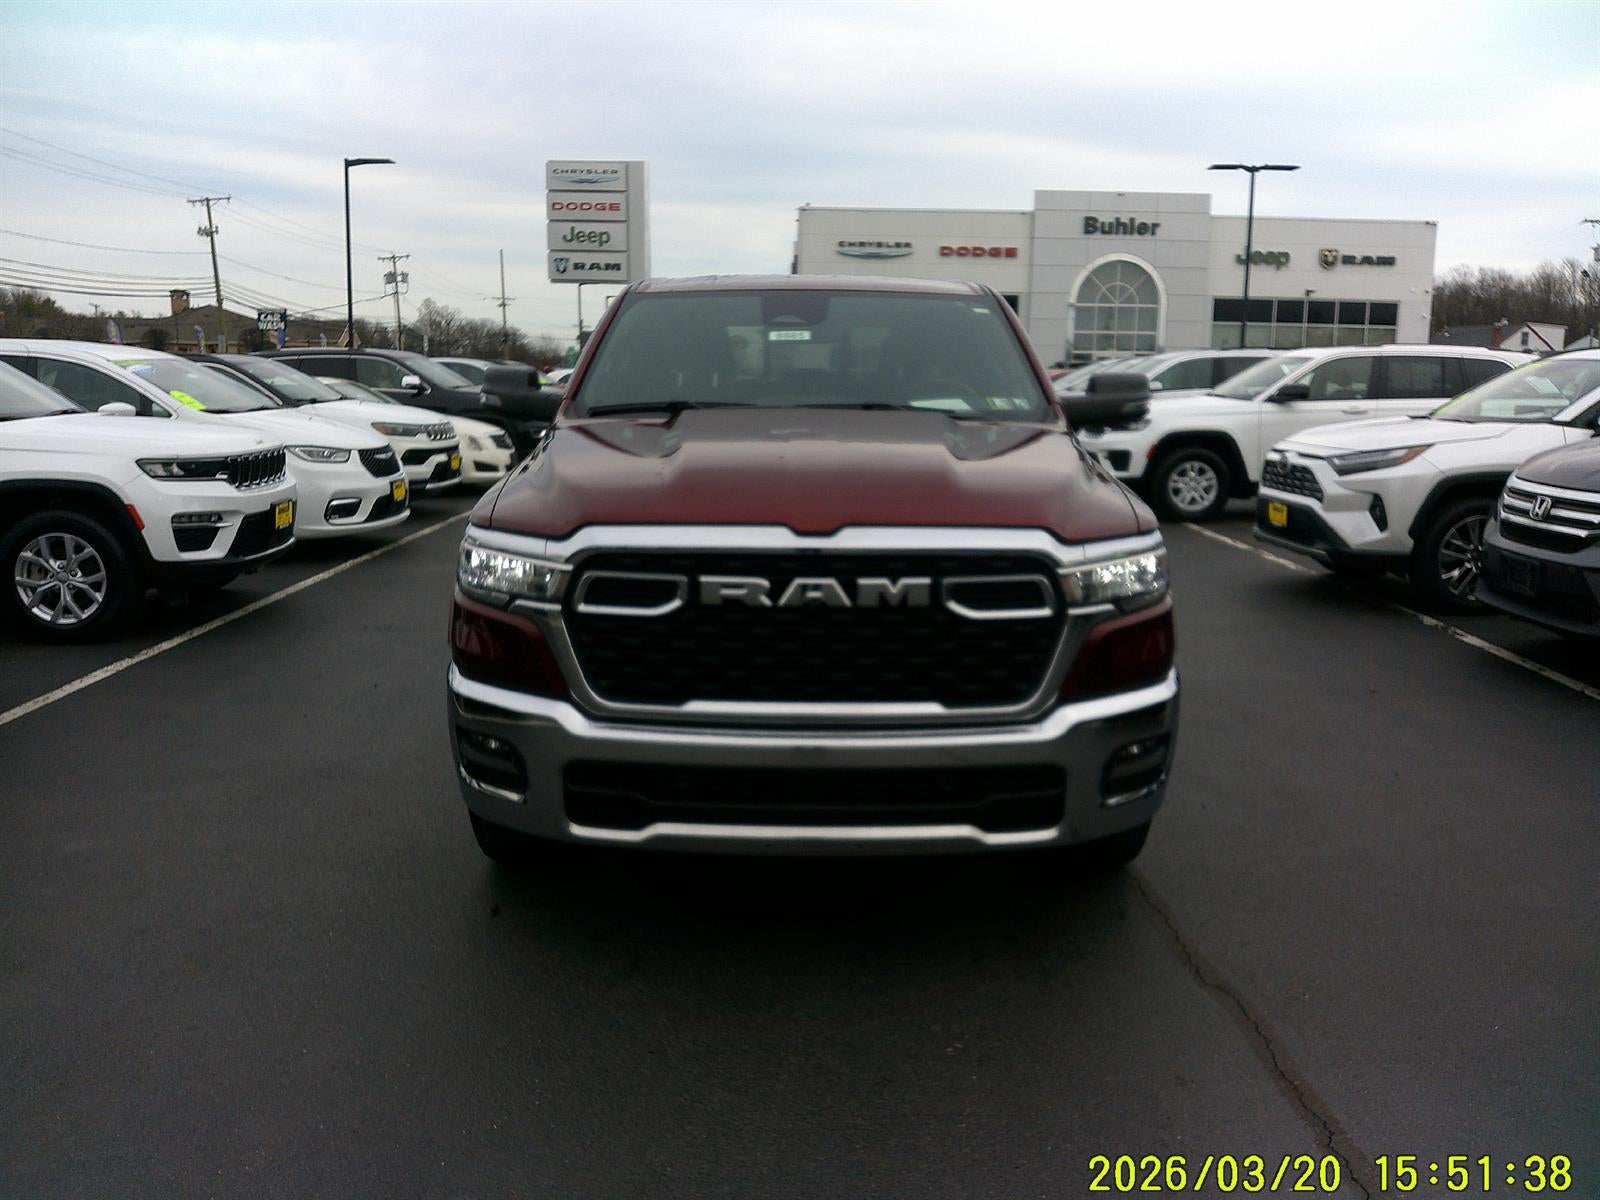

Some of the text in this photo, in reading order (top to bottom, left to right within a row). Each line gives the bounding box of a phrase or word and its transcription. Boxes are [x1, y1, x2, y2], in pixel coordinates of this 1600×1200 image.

[552, 167, 619, 175] CHRYSLER
[551, 202, 622, 212] DODGE
[1083, 215, 1161, 236] Buhler
[562, 226, 611, 247] Jeep
[838, 240, 912, 248] CHRYSLER
[939, 245, 1018, 258] DODGE
[1341, 255, 1396, 266] RAM
[573, 262, 622, 271] RAM
[699, 575, 932, 607] RAM
